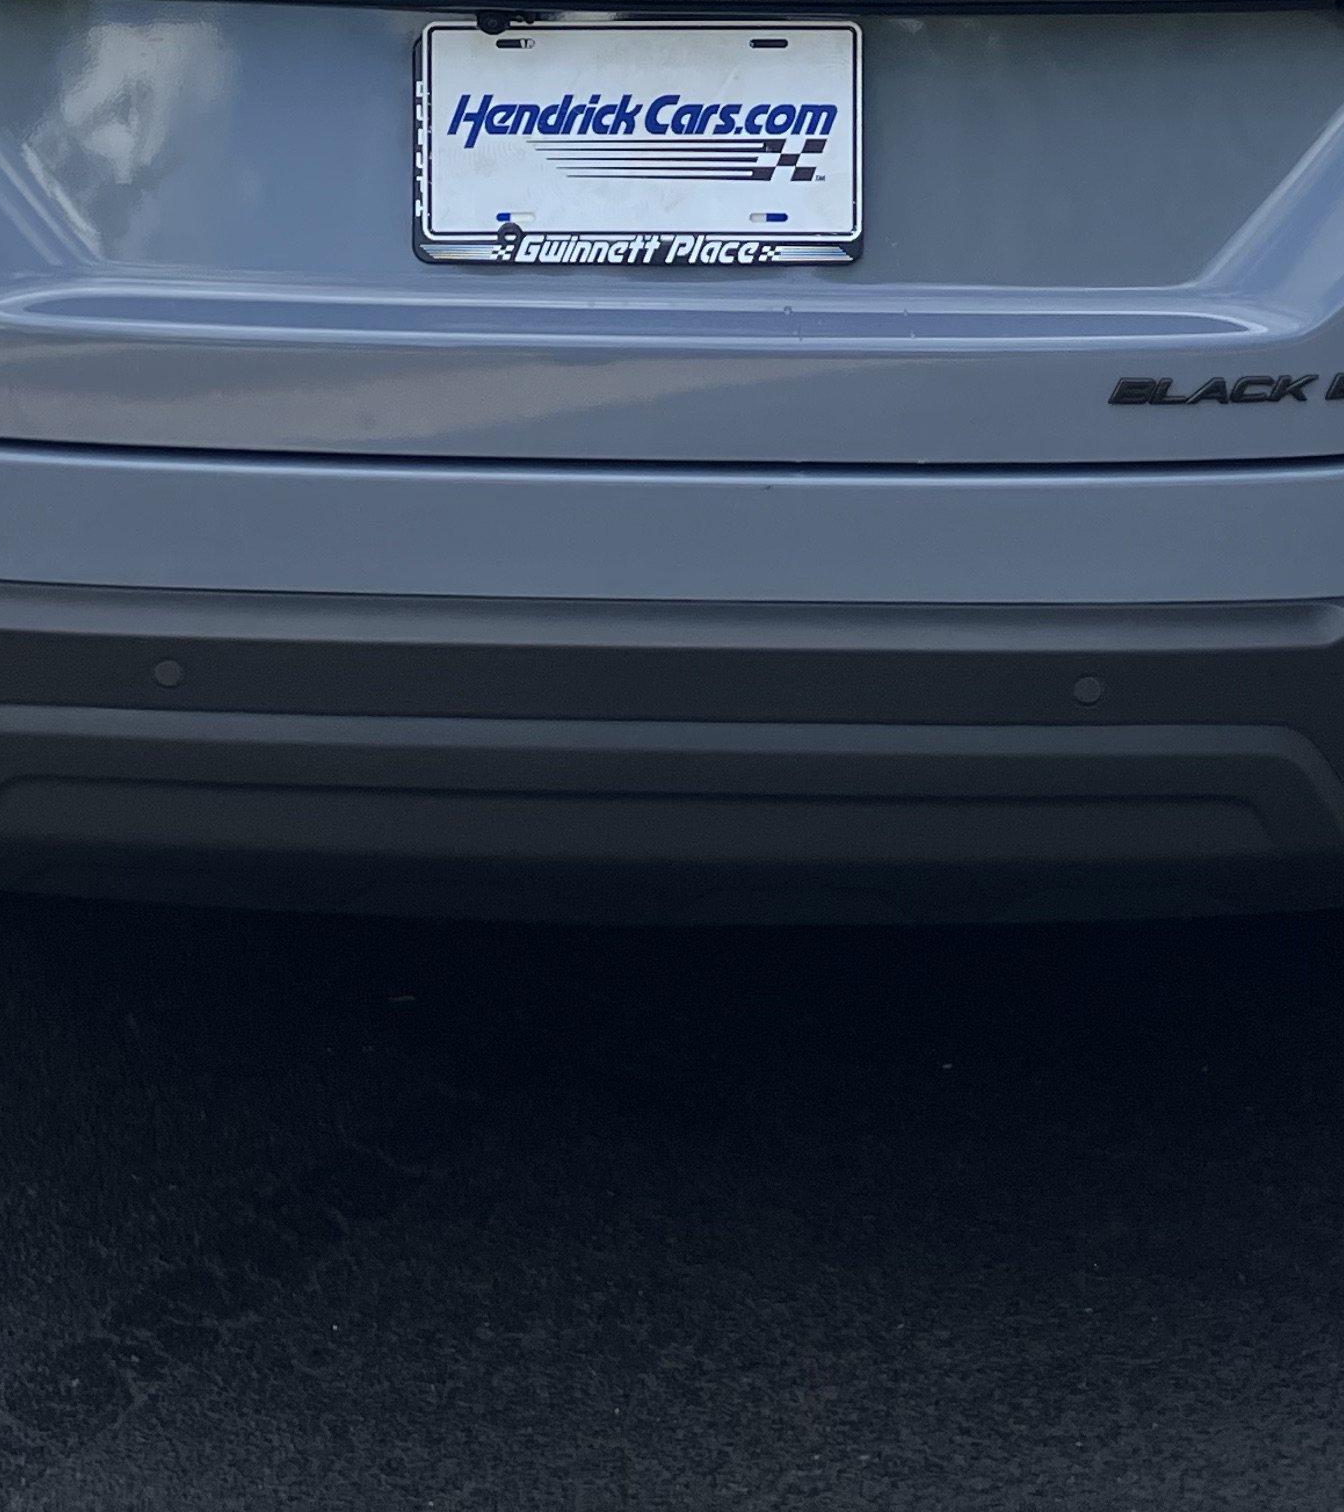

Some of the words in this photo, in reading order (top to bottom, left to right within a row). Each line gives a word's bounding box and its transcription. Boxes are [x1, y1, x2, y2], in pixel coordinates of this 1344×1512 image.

[446, 94, 839, 149] HendrickCars.com
[513, 235, 661, 264] Gwinnett
[664, 234, 760, 264] Place
[1107, 373, 1320, 406] BLACK
